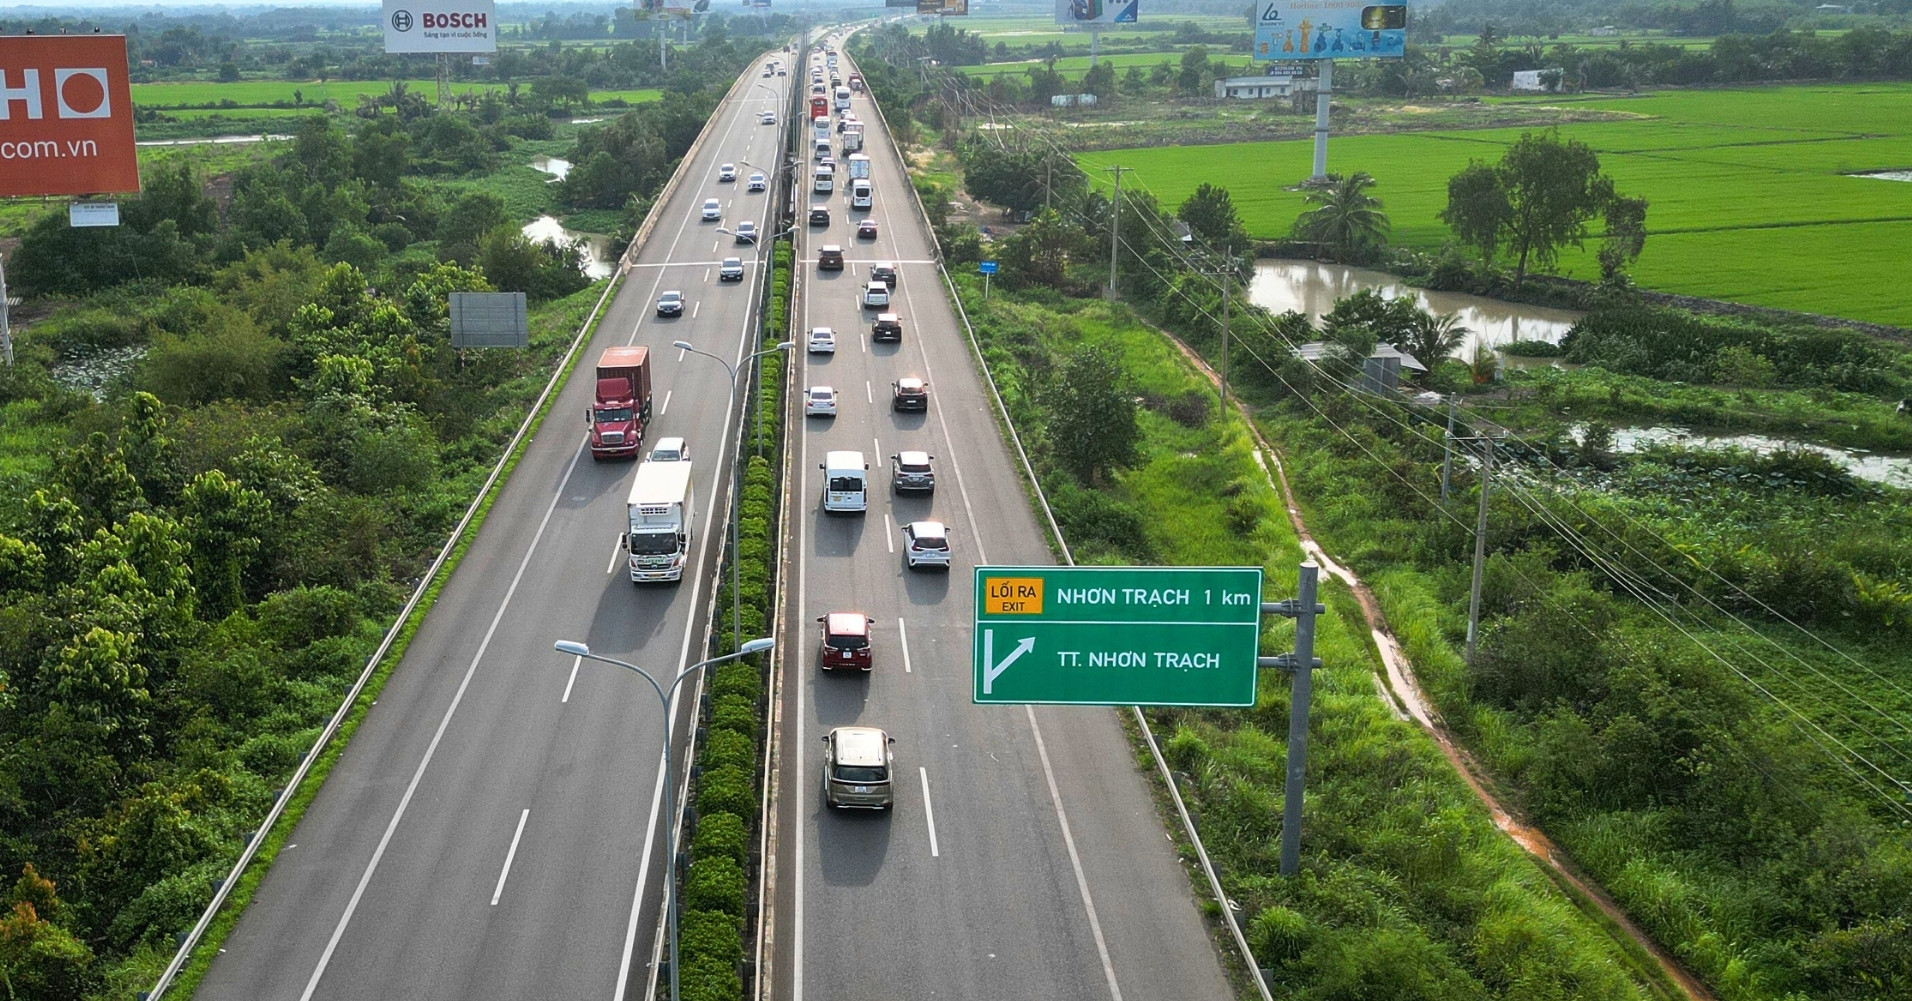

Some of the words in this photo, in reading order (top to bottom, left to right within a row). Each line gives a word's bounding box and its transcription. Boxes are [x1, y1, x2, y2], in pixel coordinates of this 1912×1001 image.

[423, 13, 487, 28] BOSCH
[991, 580, 1014, 598] LỐI
[1017, 585, 1037, 598] RA
[1057, 587, 1116, 604] NHƠN
[1122, 589, 1190, 607] TRẠCH
[1204, 589, 1211, 605] 1
[1222, 589, 1251, 605] km
[1002, 601, 1025, 612] EXIT
[1057, 651, 1082, 667] TT.
[1088, 650, 1146, 668] NHƠN
[1153, 652, 1220, 672] TRẠCH
